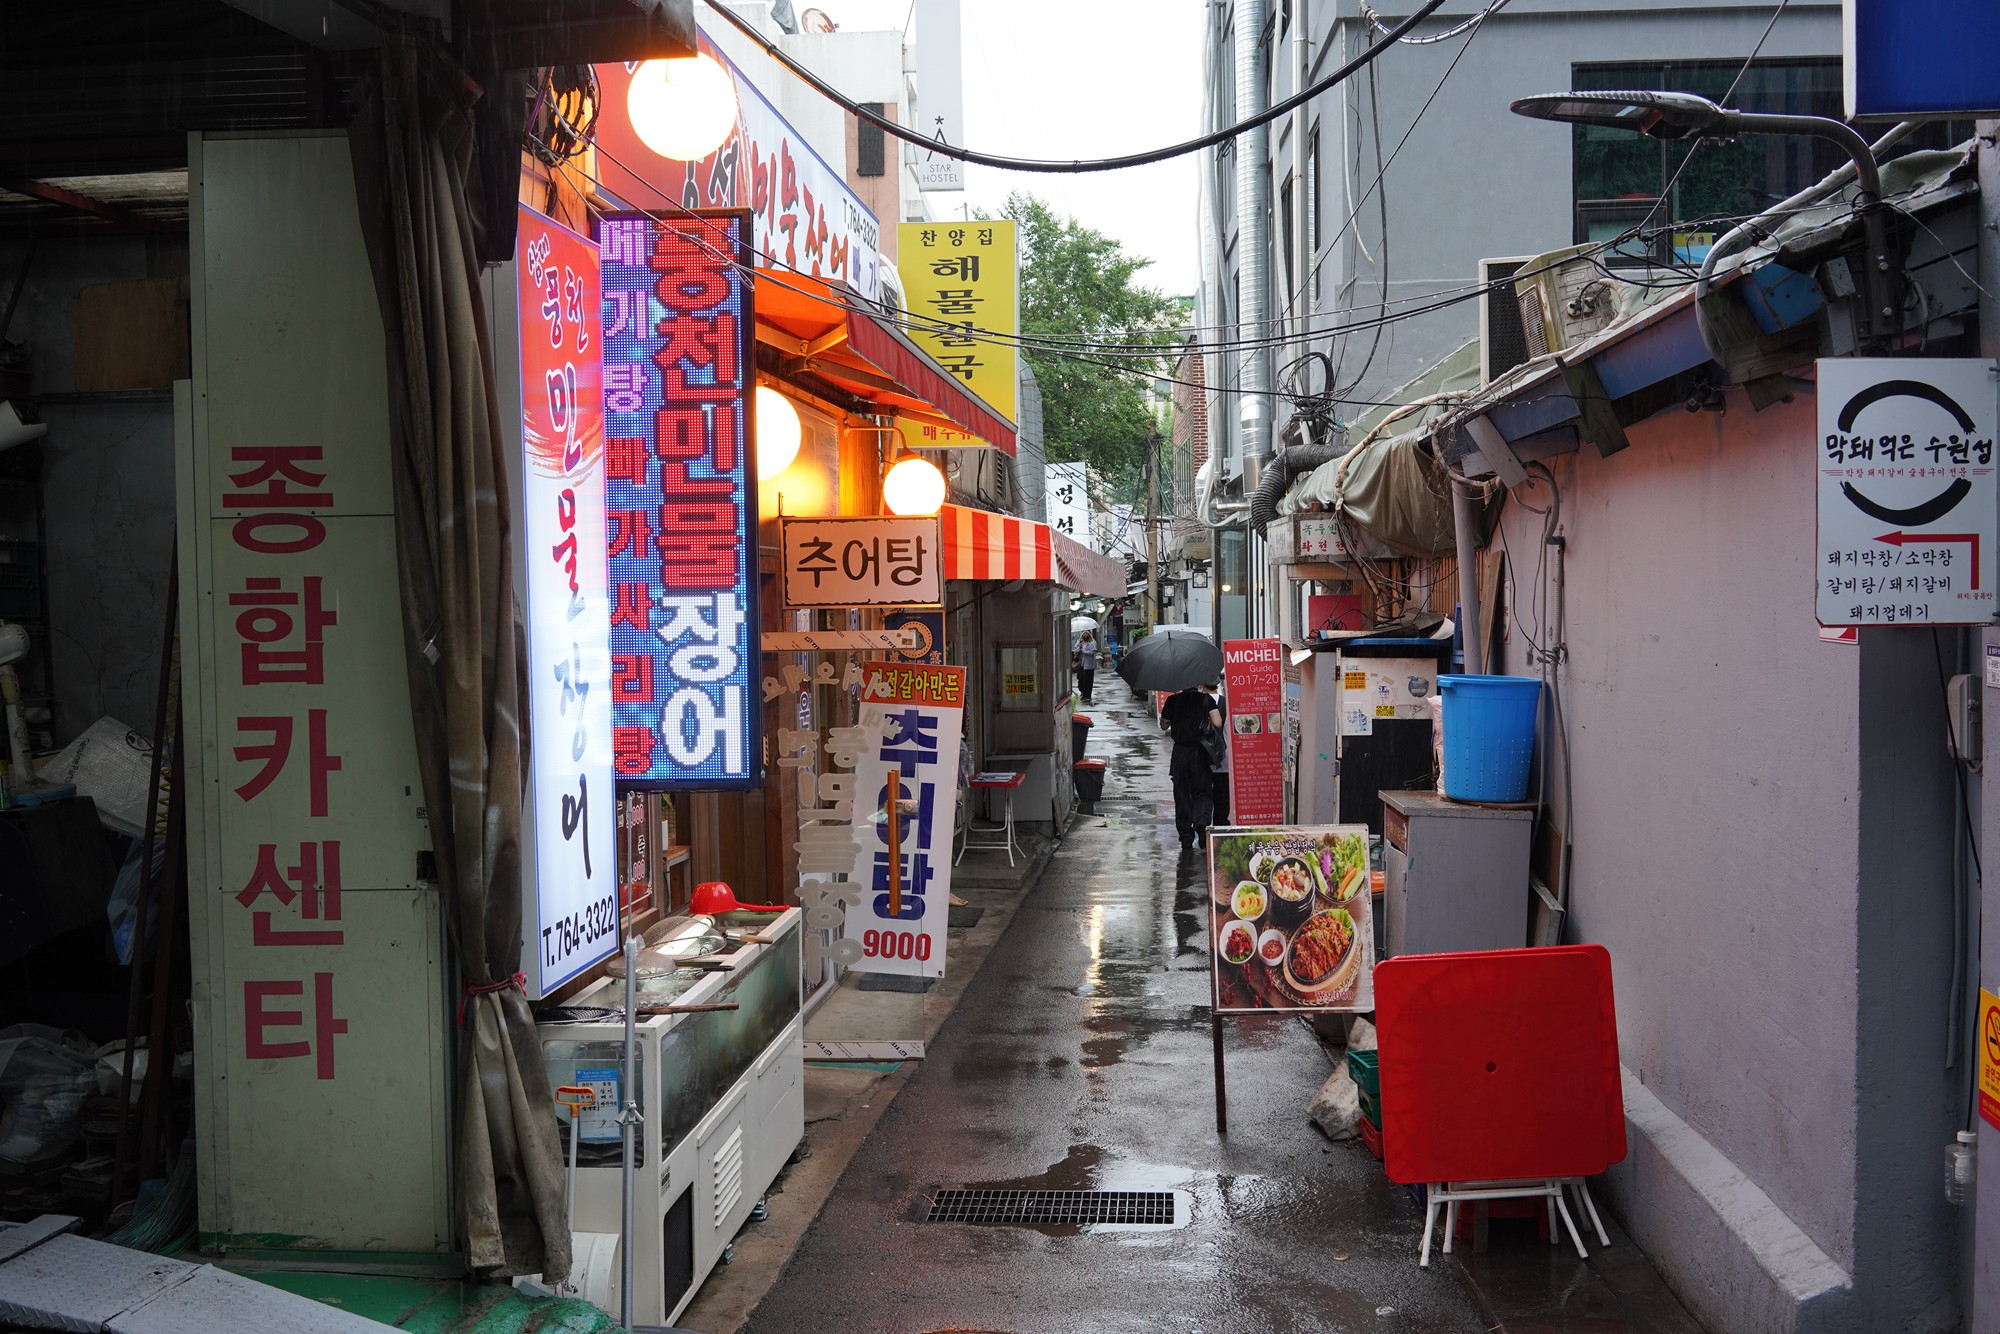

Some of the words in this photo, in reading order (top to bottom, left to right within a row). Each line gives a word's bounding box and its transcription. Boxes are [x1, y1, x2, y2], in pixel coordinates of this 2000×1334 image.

[922, 174, 959, 183] HOSTEL
[929, 164, 952, 173] STAR
[843, 196, 878, 253] T.764-3322
[920, 228, 994, 247] 찬양집
[542, 265, 588, 353] 풍천
[602, 220, 648, 412] 메기탕
[1924, 434, 1993, 465] 수원성
[1845, 468, 1864, 478] 막창
[1867, 468, 1904, 478] 돼지갈비
[1908, 468, 1945, 478] 숯불구이
[1948, 468, 1967, 478] 전문
[647, 218, 746, 774] 풍천민물장어
[796, 535, 928, 588] 추어탕
[1827, 549, 1953, 568] 돼지막창/소막창
[1827, 575, 1951, 595] 갈비탕/돼지갈비
[606, 437, 658, 775] 빠가사리탕
[1849, 603, 1929, 622] 돼지껍데기
[546, 361, 593, 880] 민물장어
[1252, 641, 1268, 649] The
[1226, 648, 1280, 664] MICHEL
[1006, 674, 1034, 683] 고기만두
[1249, 664, 1273, 673] Guide
[1006, 684, 1034, 694] 김치만두
[1231, 673, 1280, 686] 2017~20
[222, 446, 348, 1080] 종합카센타
[872, 709, 938, 921] 추어탕
[542, 894, 615, 968] T.764-3322
[863, 928, 932, 962] 9000
